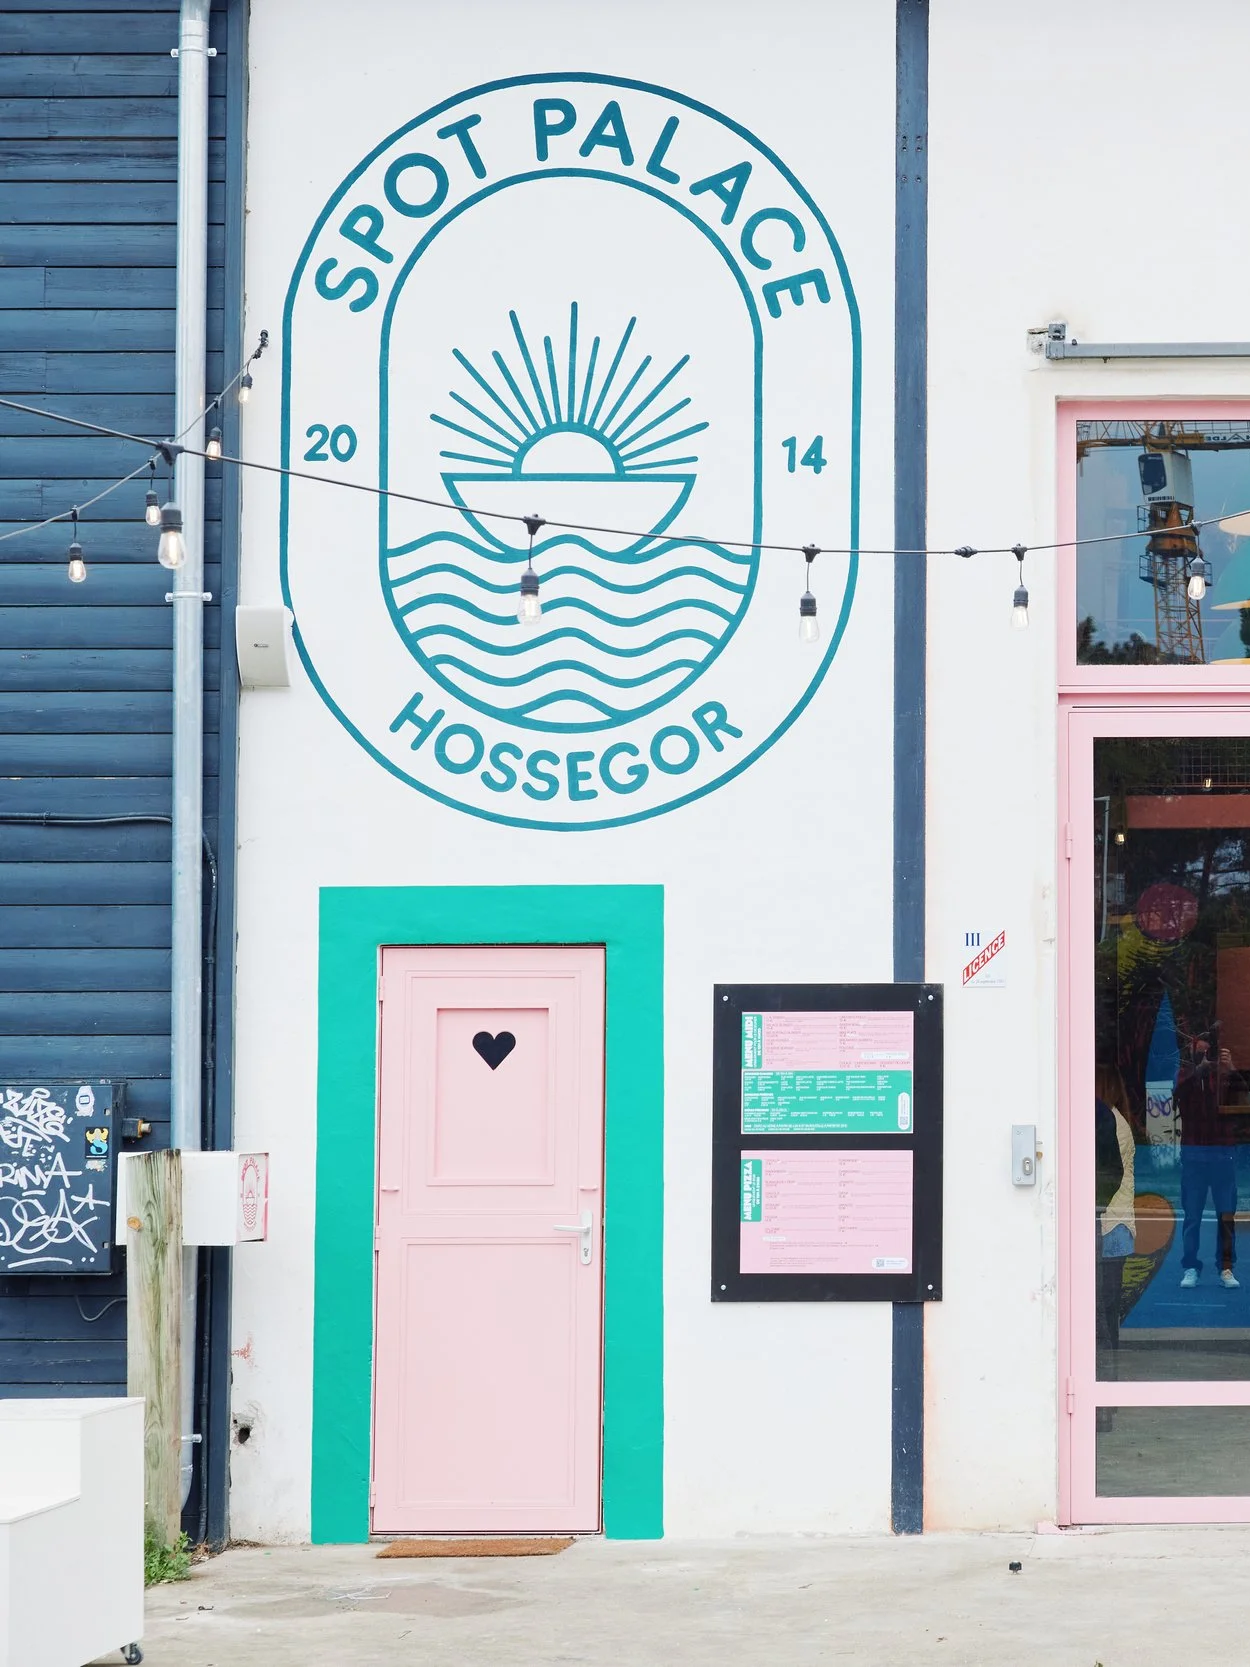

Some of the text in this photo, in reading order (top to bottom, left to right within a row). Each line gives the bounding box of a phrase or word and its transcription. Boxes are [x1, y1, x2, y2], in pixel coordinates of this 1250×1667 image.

[315, 99, 830, 319] SPOT PALACE
[304, 424, 357, 462] 20
[782, 436, 827, 474] 14
[389, 693, 743, 801] HOSSEGOR
[963, 933, 1004, 983] LICENCE
[744, 1016, 753, 1067] MENU MIDI
[743, 1161, 752, 1220] MENU PIZZA
